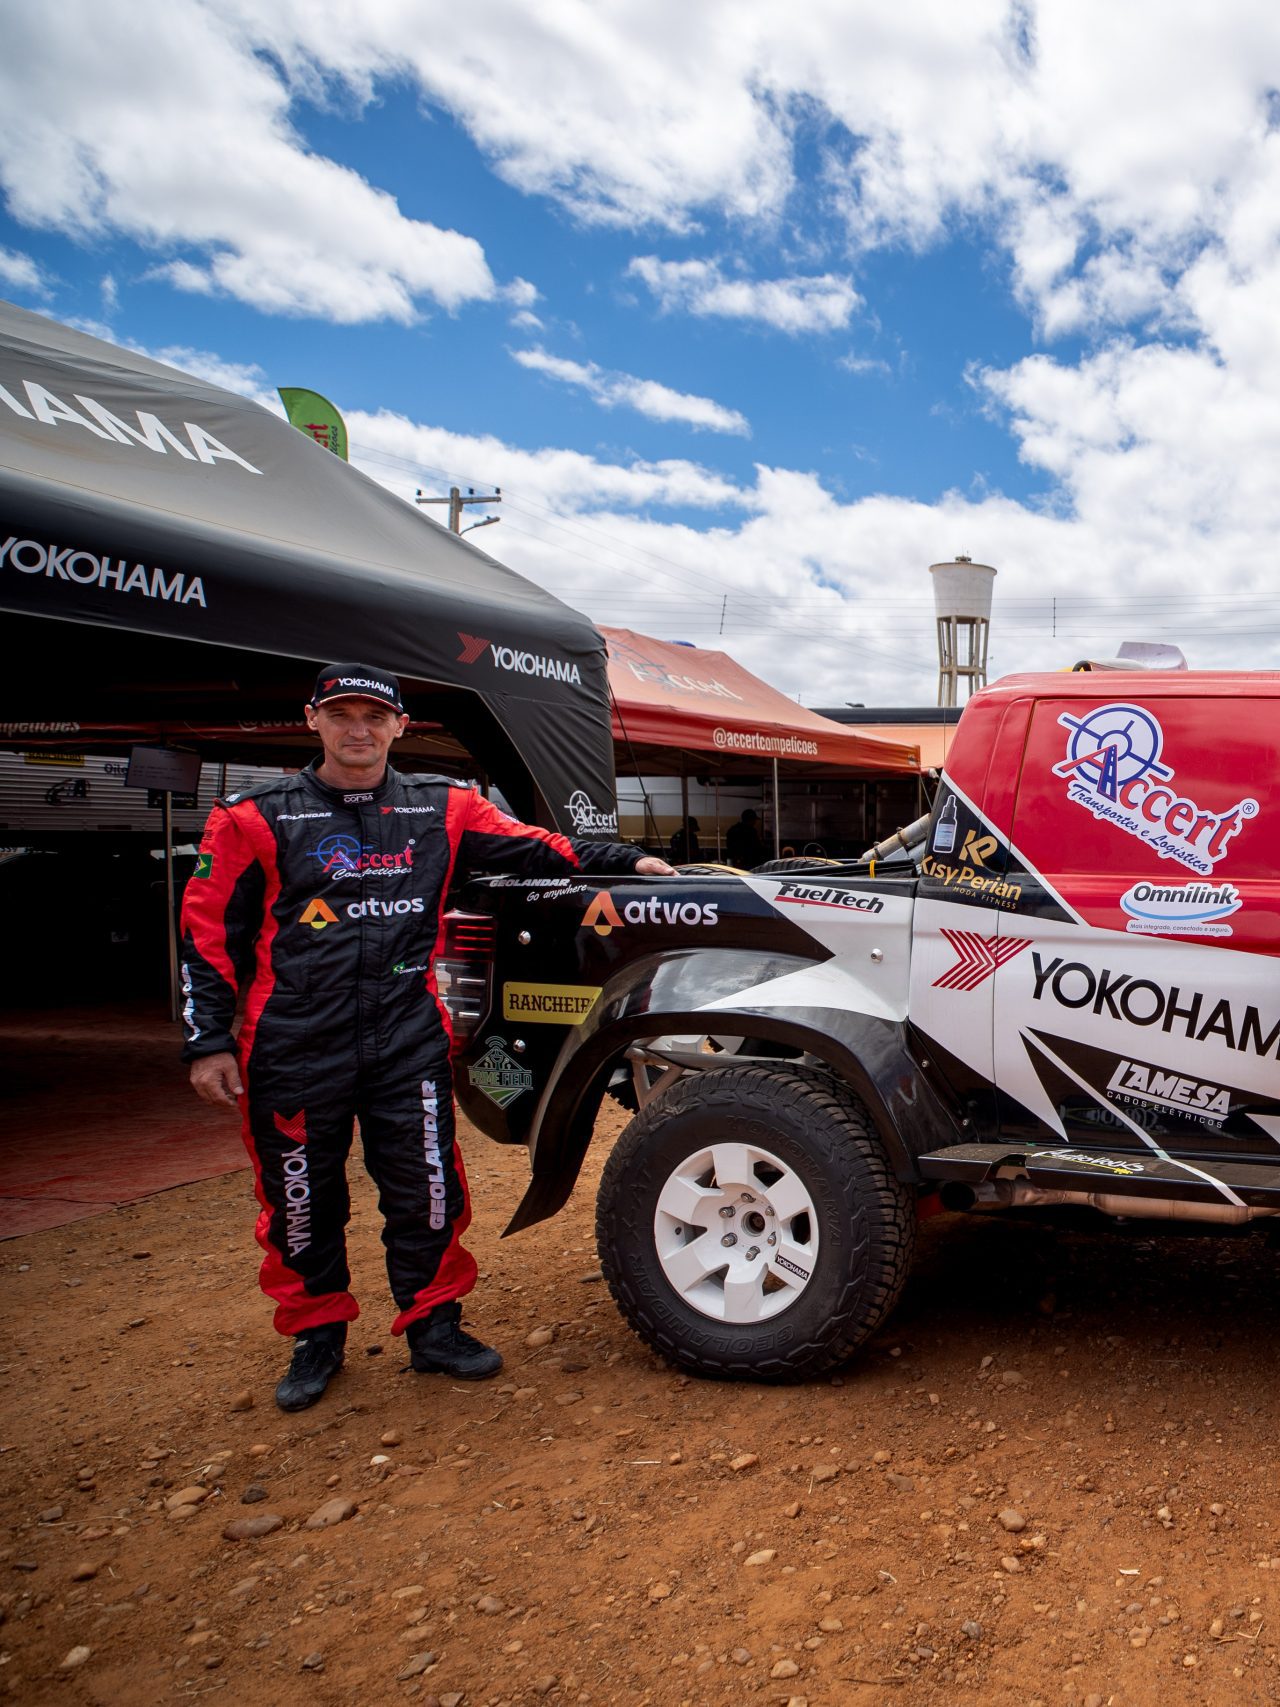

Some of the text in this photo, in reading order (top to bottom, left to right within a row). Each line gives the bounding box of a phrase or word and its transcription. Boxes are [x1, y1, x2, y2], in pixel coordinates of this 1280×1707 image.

[490, 643, 582, 685] YOKOHAMA
[338, 677, 394, 697] YOKOHAMA
[712, 727, 818, 756] @accertcompeticoes
[393, 805, 436, 814] YOKOHAMA
[1057, 743, 1240, 858] Accert
[1072, 783, 1139, 832] Transportes
[1140, 828, 1149, 838] e
[322, 844, 414, 873] Accert
[489, 878, 571, 888] GEOLANDAR
[526, 883, 588, 902] Go anywhere
[921, 855, 1022, 901] Kisy Perian
[347, 898, 425, 918] atvos
[777, 882, 884, 914] FuelTech
[981, 894, 1017, 910] FITNESS
[1133, 885, 1235, 905] Omnilink
[624, 896, 719, 926] atvos
[501, 1072, 532, 1088] FIELD
[1106, 1059, 1231, 1116] LAMESA
[1106, 1091, 1148, 1109] CABOS
[1153, 1104, 1223, 1130] ELÉTRICOS
[421, 1080, 446, 1231] GEOLANDAR
[281, 1144, 313, 1258] YOKOHAMA
[777, 1256, 808, 1280] YOKOHAMA
